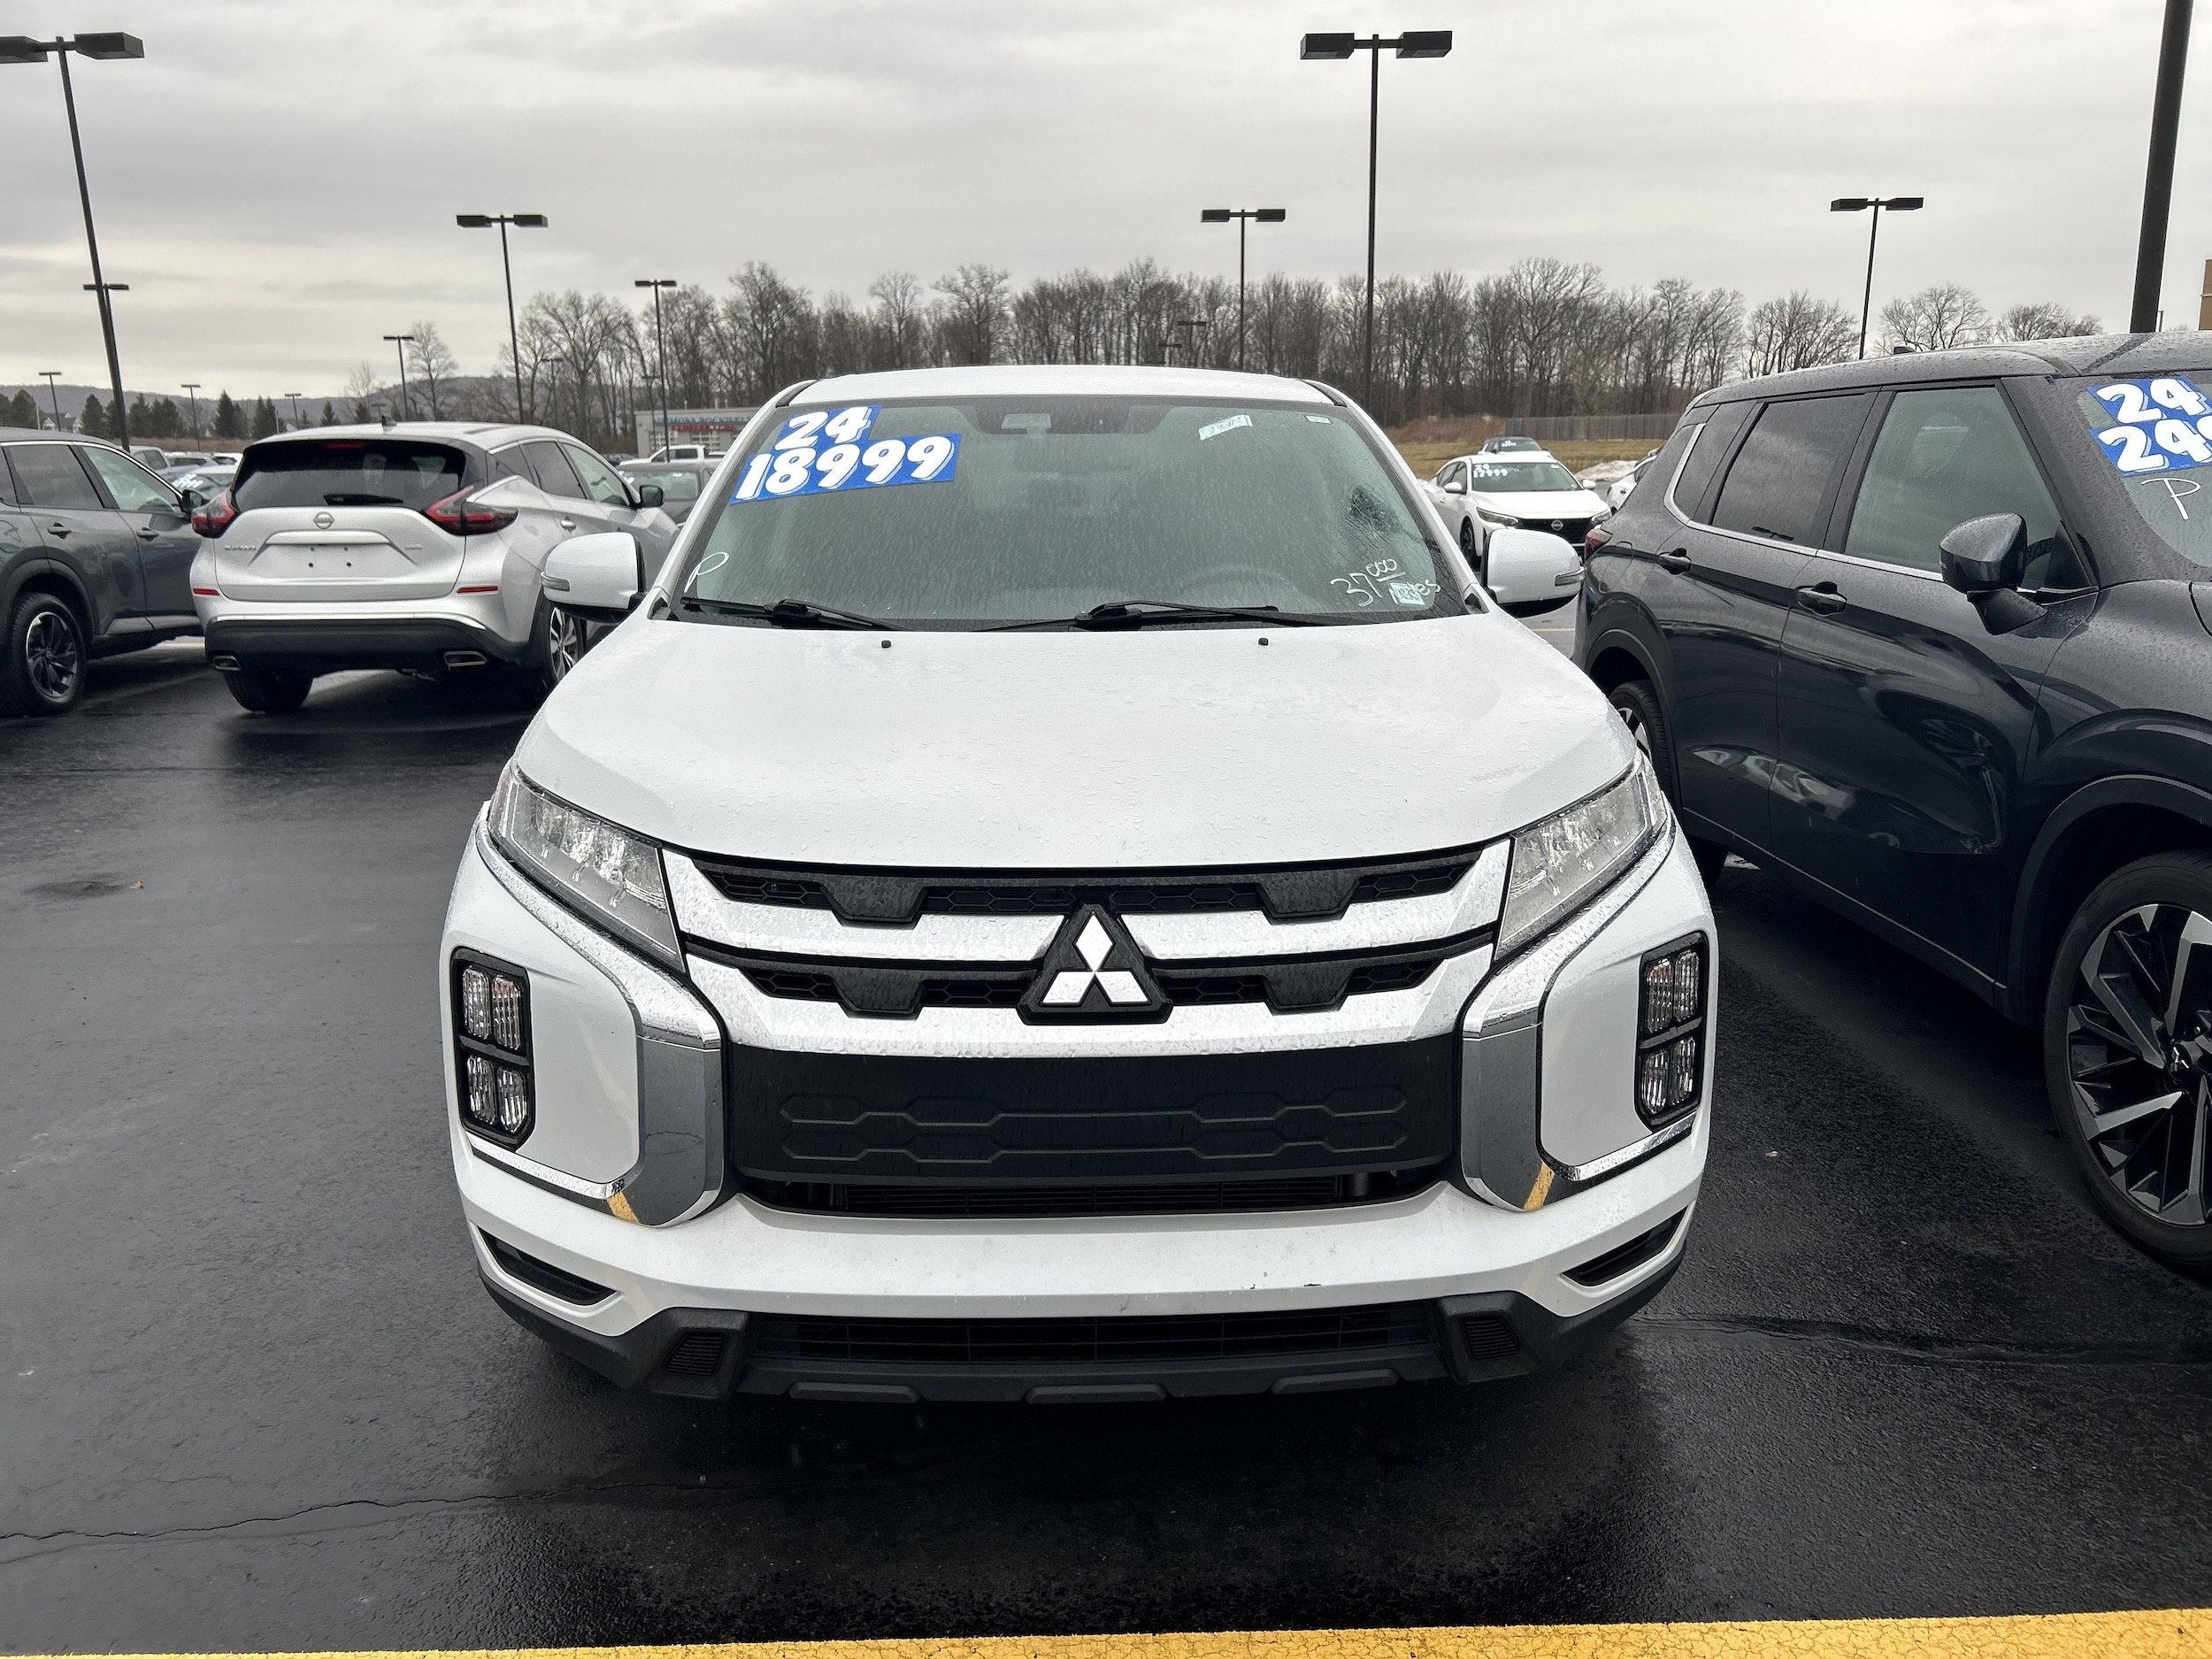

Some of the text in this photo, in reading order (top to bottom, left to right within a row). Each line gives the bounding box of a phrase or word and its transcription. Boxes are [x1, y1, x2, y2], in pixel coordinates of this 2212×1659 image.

[2096, 378, 2212, 424] 24
[774, 406, 872, 450] 24
[2097, 415, 2212, 472] 24
[735, 436, 956, 501] 18999
[2140, 477, 2201, 520] P
